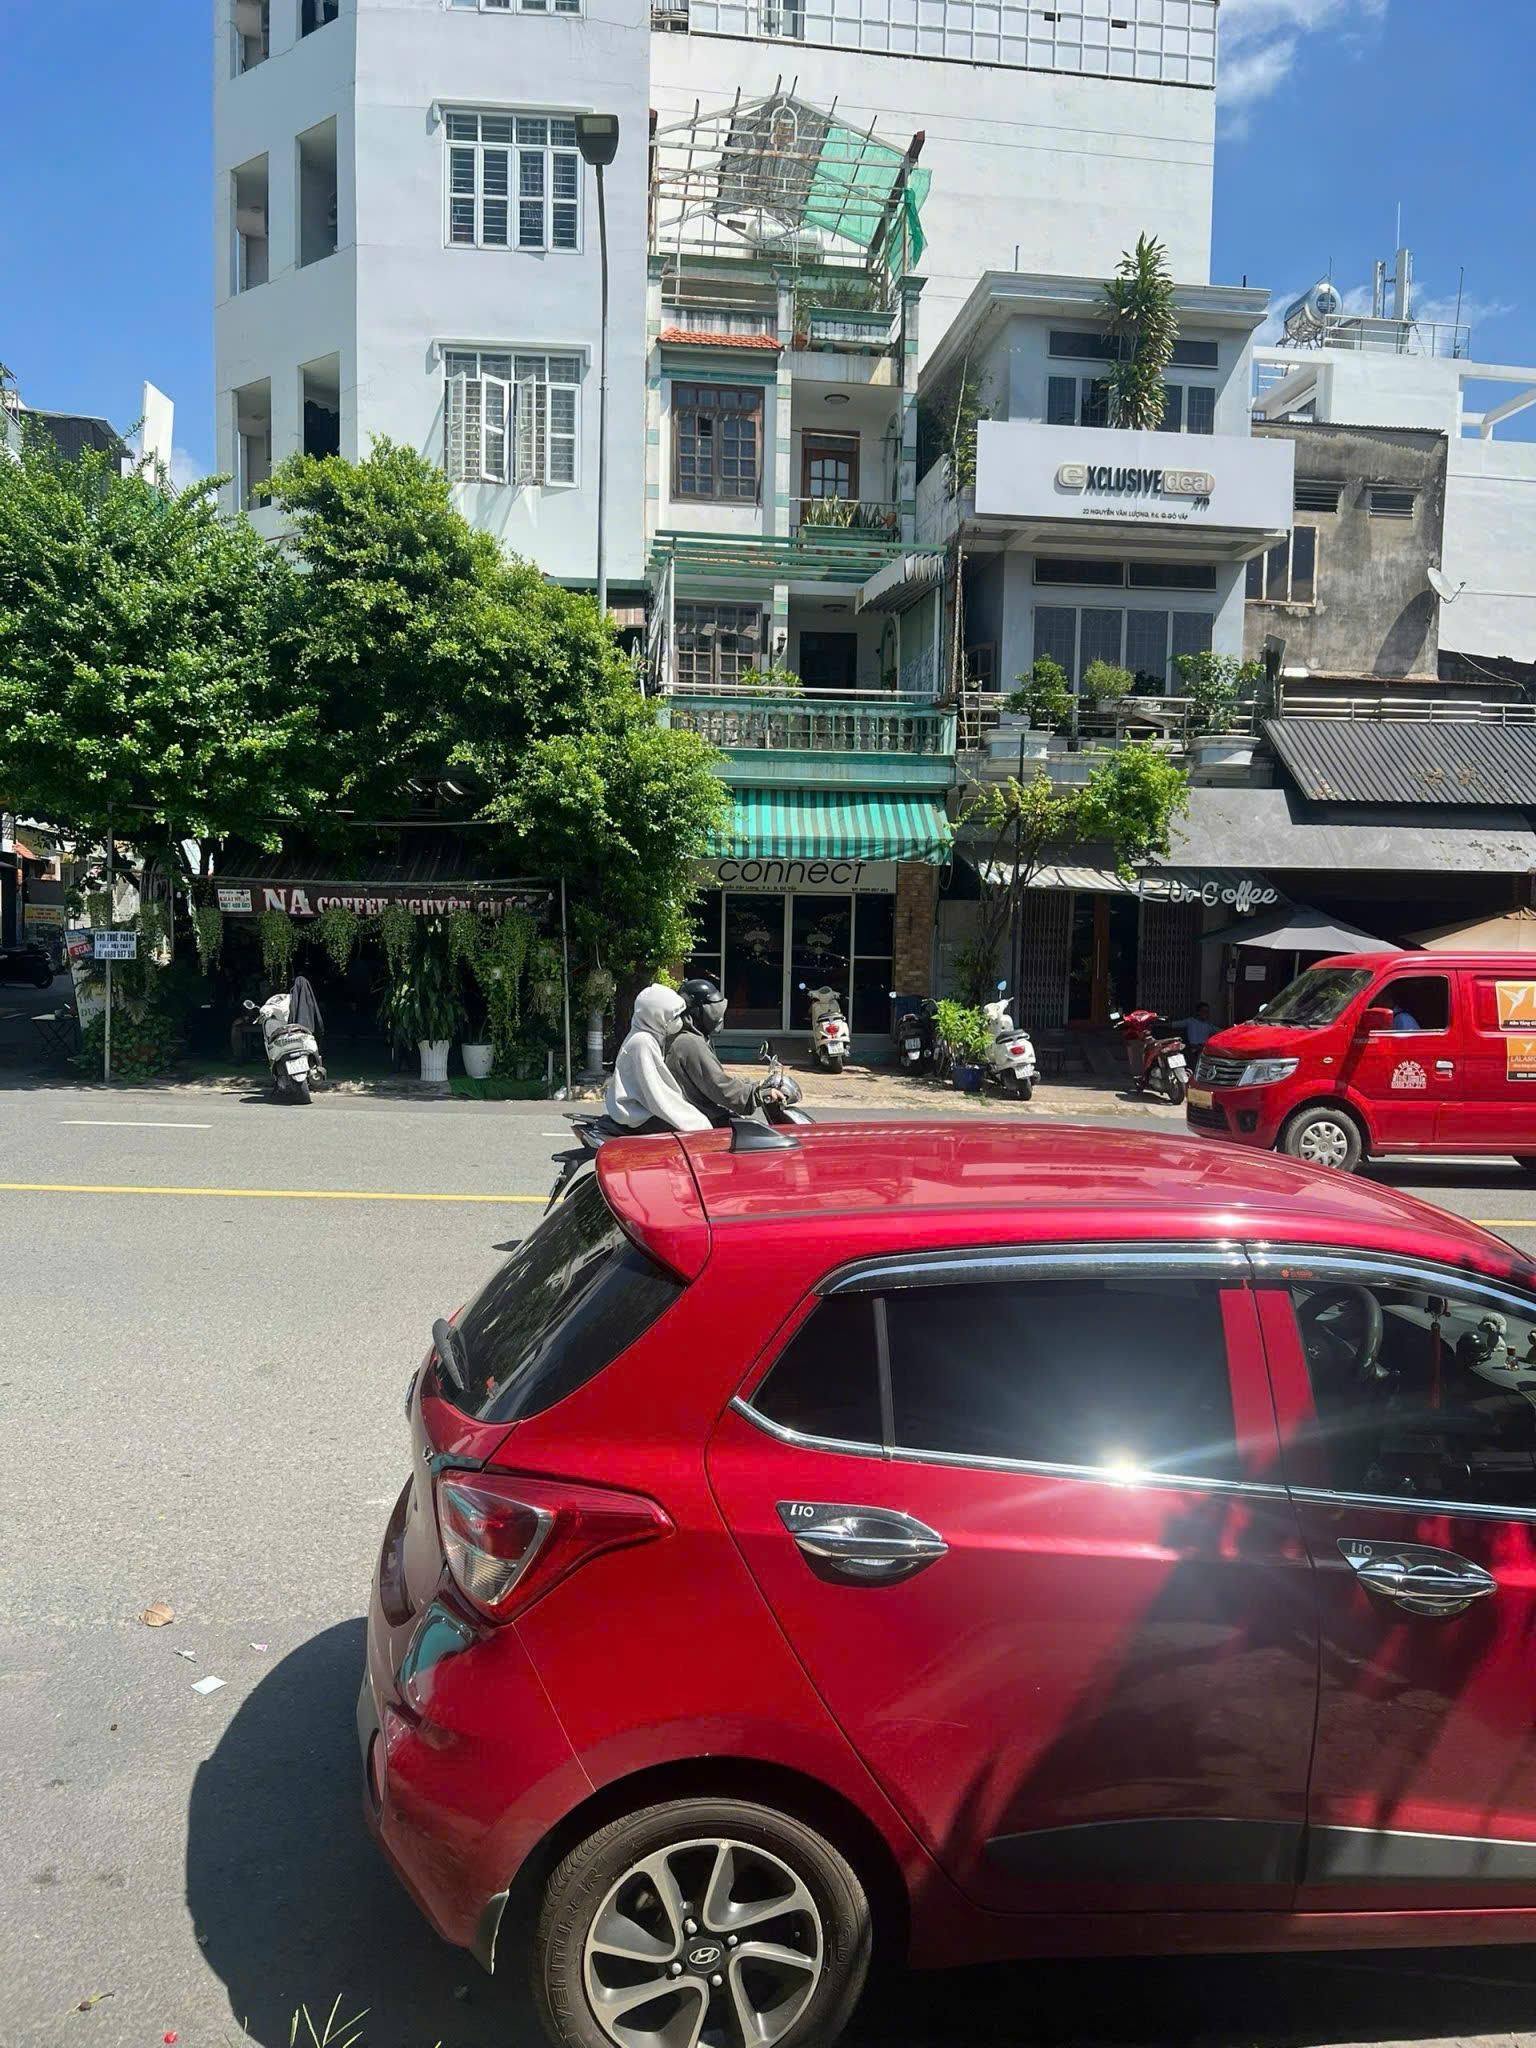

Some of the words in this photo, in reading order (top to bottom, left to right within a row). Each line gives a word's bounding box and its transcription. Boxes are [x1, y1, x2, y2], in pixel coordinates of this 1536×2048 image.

[717, 860, 867, 885] connect
[262, 888, 313, 914] NA
[316, 896, 389, 915] COFFEE
[1202, 880, 1279, 912] Coffee
